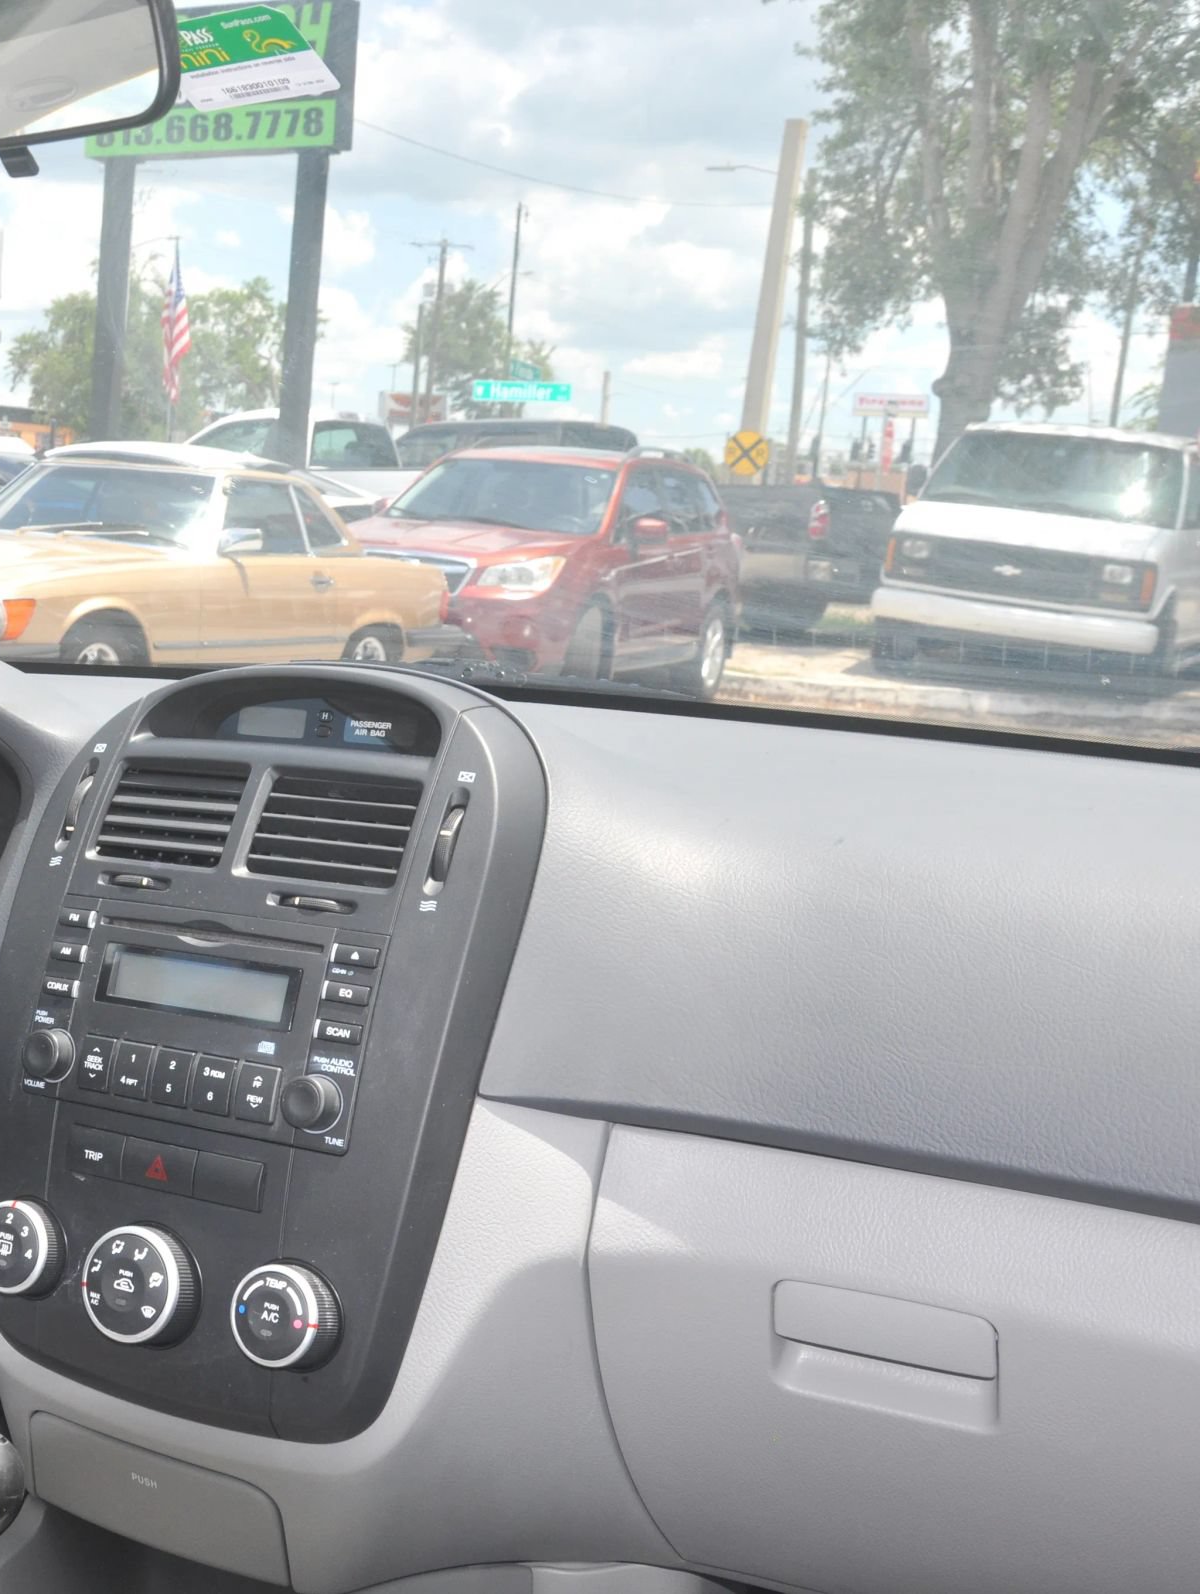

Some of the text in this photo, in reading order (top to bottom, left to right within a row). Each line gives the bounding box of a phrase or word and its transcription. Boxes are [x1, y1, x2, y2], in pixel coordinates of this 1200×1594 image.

[322, 712, 329, 720] H
[351, 719, 392, 730] PASSENGER
[370, 730, 386, 738] BAG
[69, 913, 80, 922] FM
[60, 947, 72, 955] AM
[339, 988, 353, 998] EQ
[35, 1015, 55, 1025] POWER
[326, 1026, 351, 1039] SCAN
[86, 1054, 103, 1064] SEEK
[131, 1054, 137, 1063] 1
[329, 1057, 354, 1068] AUDIO
[84, 1061, 104, 1071] TRACK
[169, 1060, 177, 1070] 2
[321, 1063, 355, 1076] CONTROL
[203, 1067, 226, 1080] 3 RDM
[24, 1079, 46, 1089] VOLUME
[120, 1075, 139, 1087] 4 RPT
[252, 1080, 263, 1088] FF
[165, 1083, 172, 1093] 5
[207, 1091, 214, 1101] 6
[246, 1094, 264, 1104] REW
[324, 1136, 345, 1147] TUNE
[84, 1149, 104, 1162] TRIP
[5, 1212, 14, 1224] 2
[0, 1231, 14, 1241] PUSH
[20, 1225, 29, 1237] 3
[24, 1249, 32, 1260] 4
[118, 1268, 134, 1278] PUSH
[264, 1277, 288, 1291] TEMP
[90, 1291, 101, 1300] MAX
[264, 1301, 280, 1312] PUSH
[261, 1311, 280, 1324] A/C
[131, 1471, 158, 1489] PUSH
